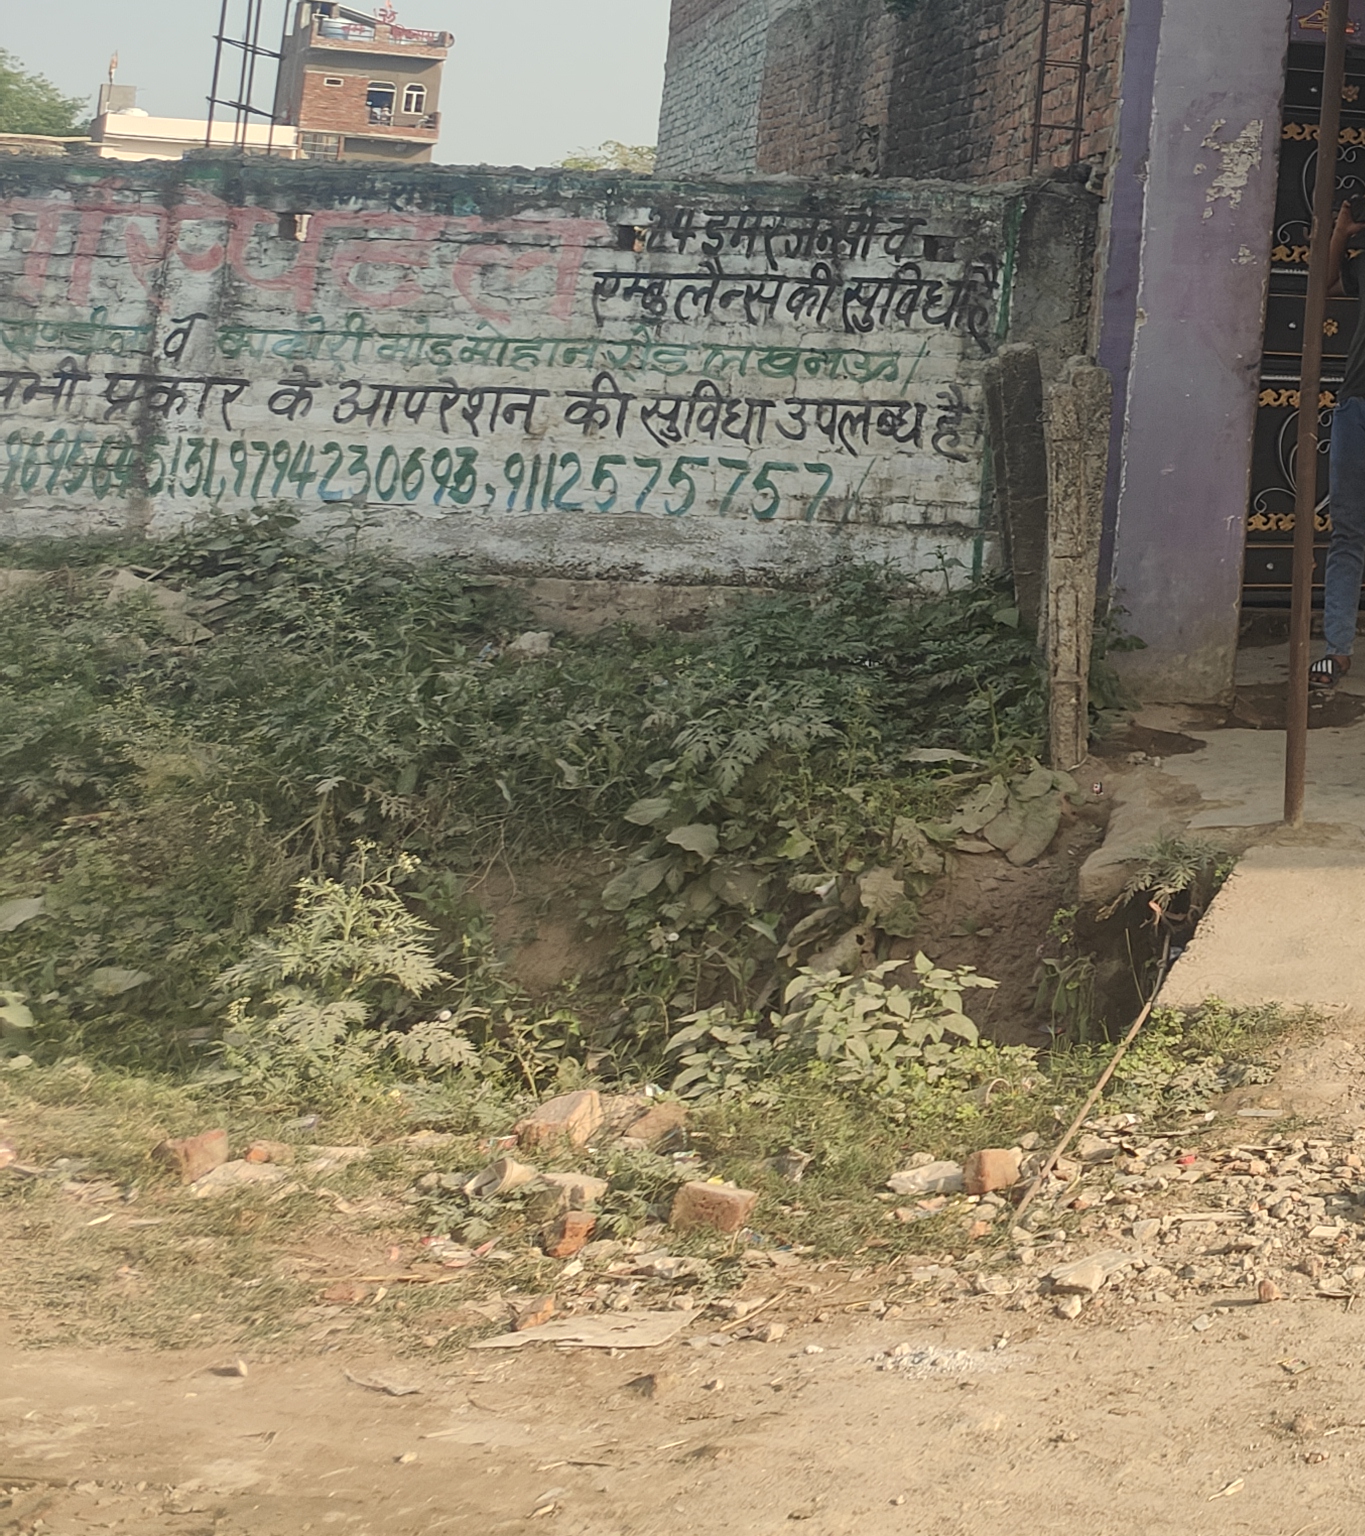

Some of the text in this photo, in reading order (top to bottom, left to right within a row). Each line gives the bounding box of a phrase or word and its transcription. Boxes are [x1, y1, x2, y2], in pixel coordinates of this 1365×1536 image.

[104, 372, 250, 431] प्रकार
[268, 365, 322, 421] के
[564, 371, 637, 439] की
[641, 380, 776, 448] सुविधा
[775, 398, 927, 458] उपलब्ध
